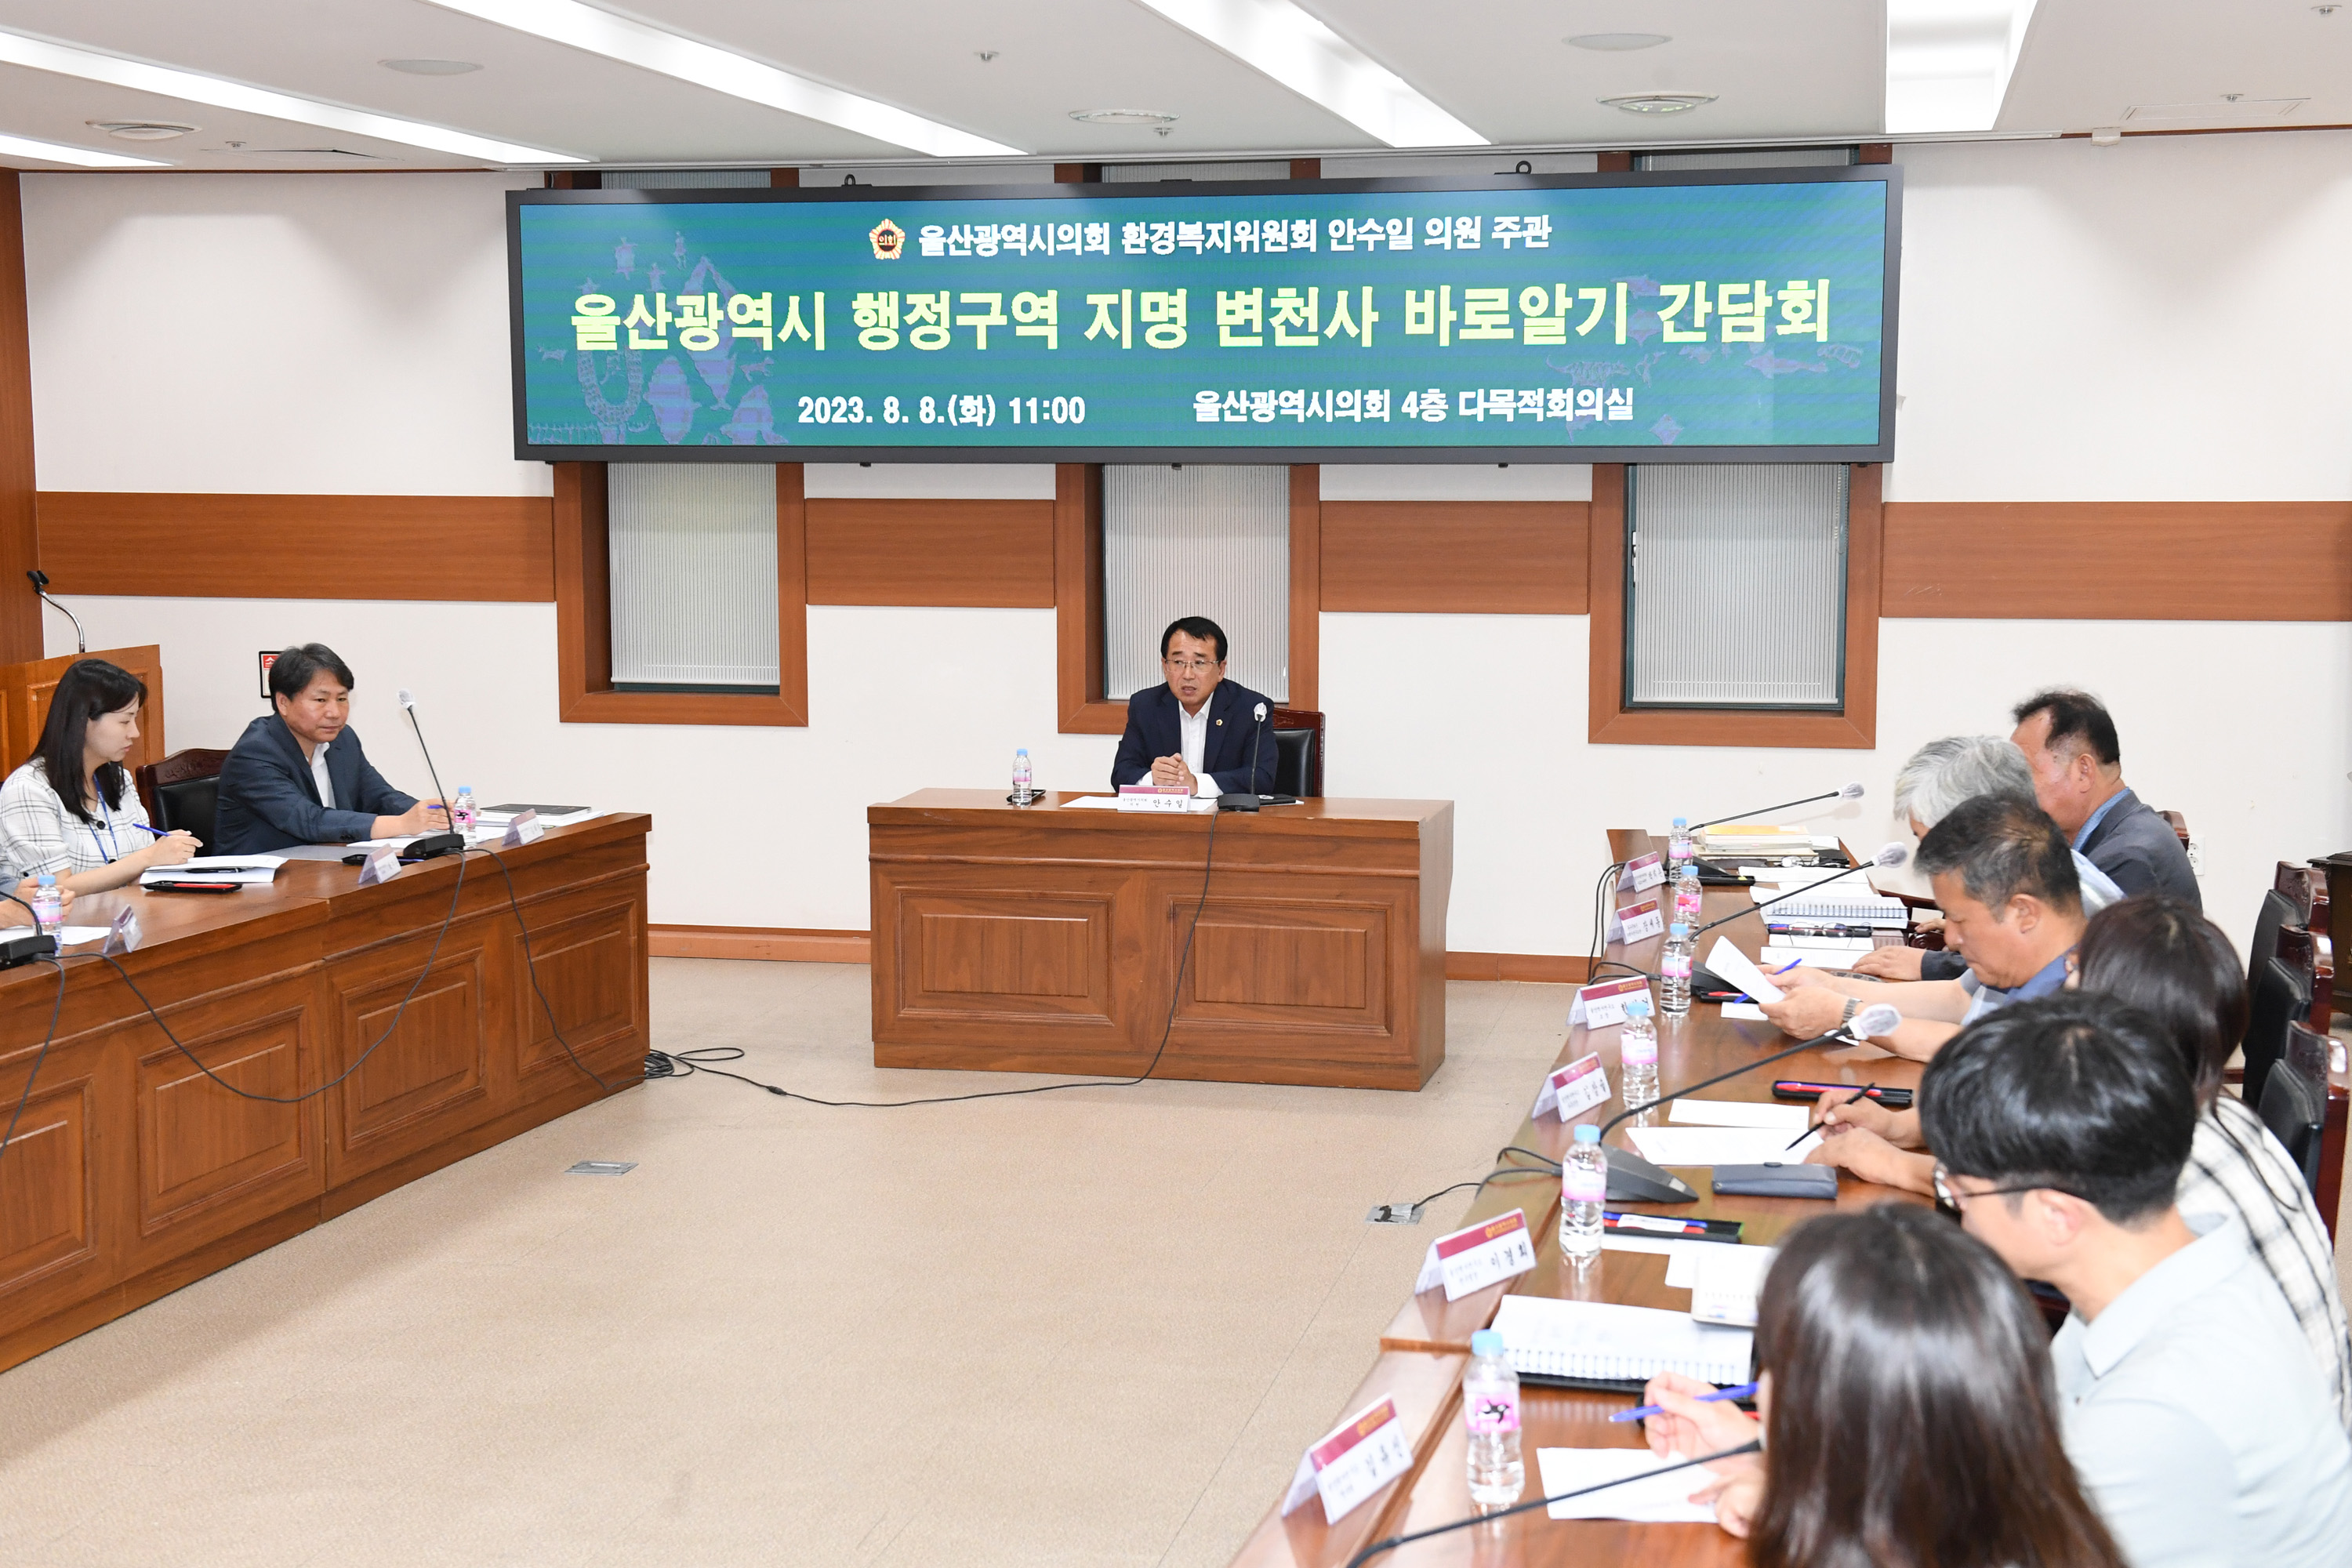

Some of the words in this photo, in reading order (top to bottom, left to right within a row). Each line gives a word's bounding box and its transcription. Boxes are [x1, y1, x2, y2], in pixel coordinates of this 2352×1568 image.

[918, 222, 1110, 257] 울산광역시의회
[1121, 219, 1317, 256] 환경복지위원회
[1328, 216, 1414, 252] 안수일
[1424, 216, 1482, 251] 의원
[1491, 214, 1552, 249] 주관
[571, 292, 825, 351] 울산광역시
[851, 289, 1058, 351] 행정구역
[1083, 288, 1187, 350] 지명
[1216, 285, 1379, 347] 변천사
[1405, 281, 1628, 347] 바로알기
[1657, 278, 1830, 343] 간담회
[798, 396, 873, 424] 2023.
[883, 396, 909, 424] 8.
[919, 394, 996, 427] 8.(화)
[1009, 396, 1086, 424] 11:00
[1192, 389, 1390, 423] 울산광역시의회
[1401, 388, 1449, 423] 4층
[1458, 387, 1634, 423] 다목적회의실
